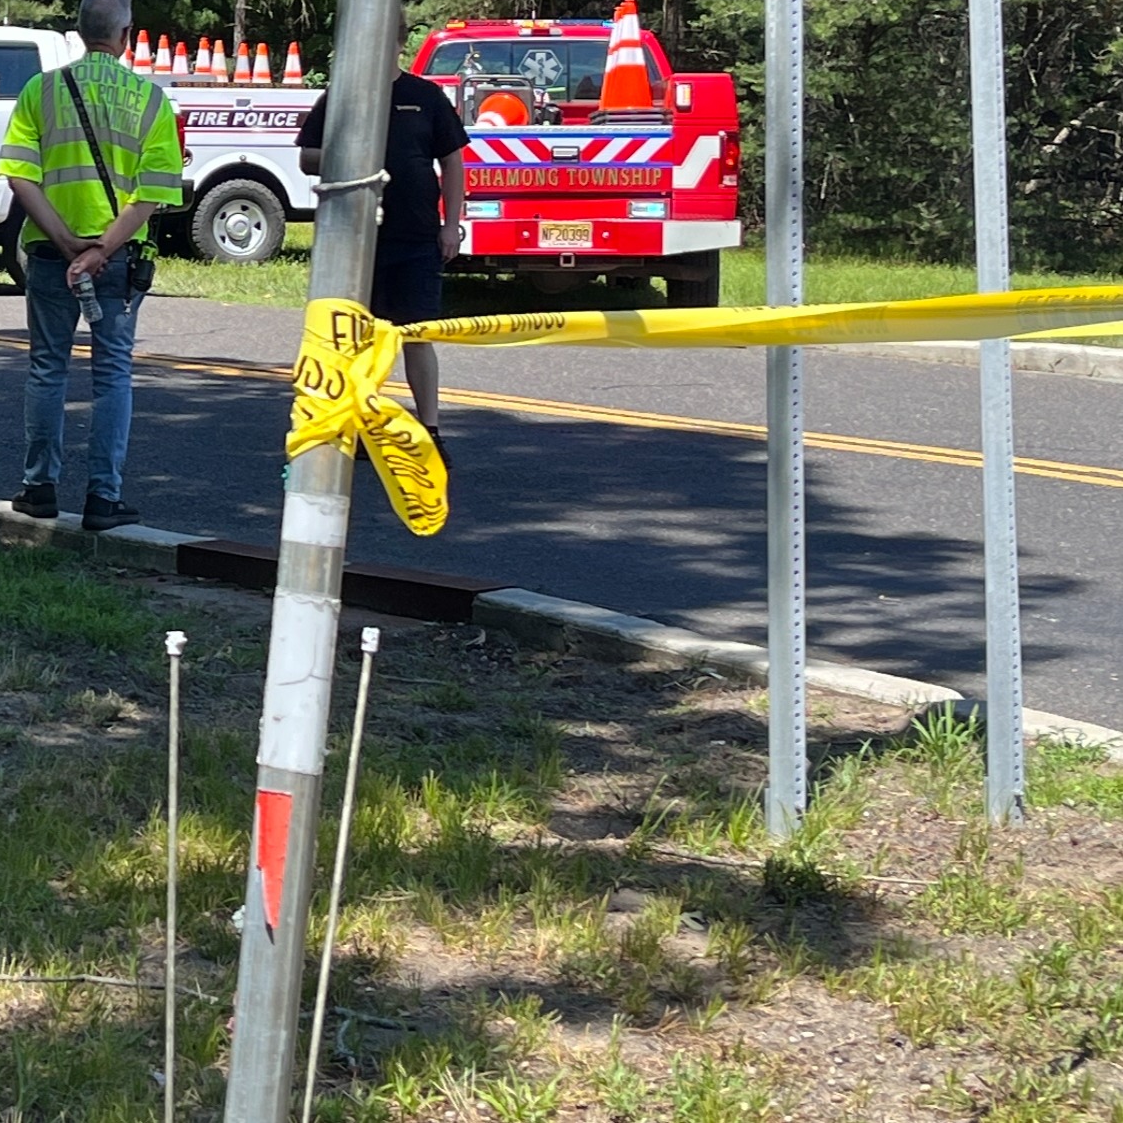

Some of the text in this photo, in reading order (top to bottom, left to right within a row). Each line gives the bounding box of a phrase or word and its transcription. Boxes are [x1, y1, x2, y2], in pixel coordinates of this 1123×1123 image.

[60, 63, 146, 92] OUNTY
[99, 83, 144, 114] POLICE
[187, 112, 299, 127] FIRE POLICE
[469, 167, 663, 187] SHAMONG TOWNSHIP
